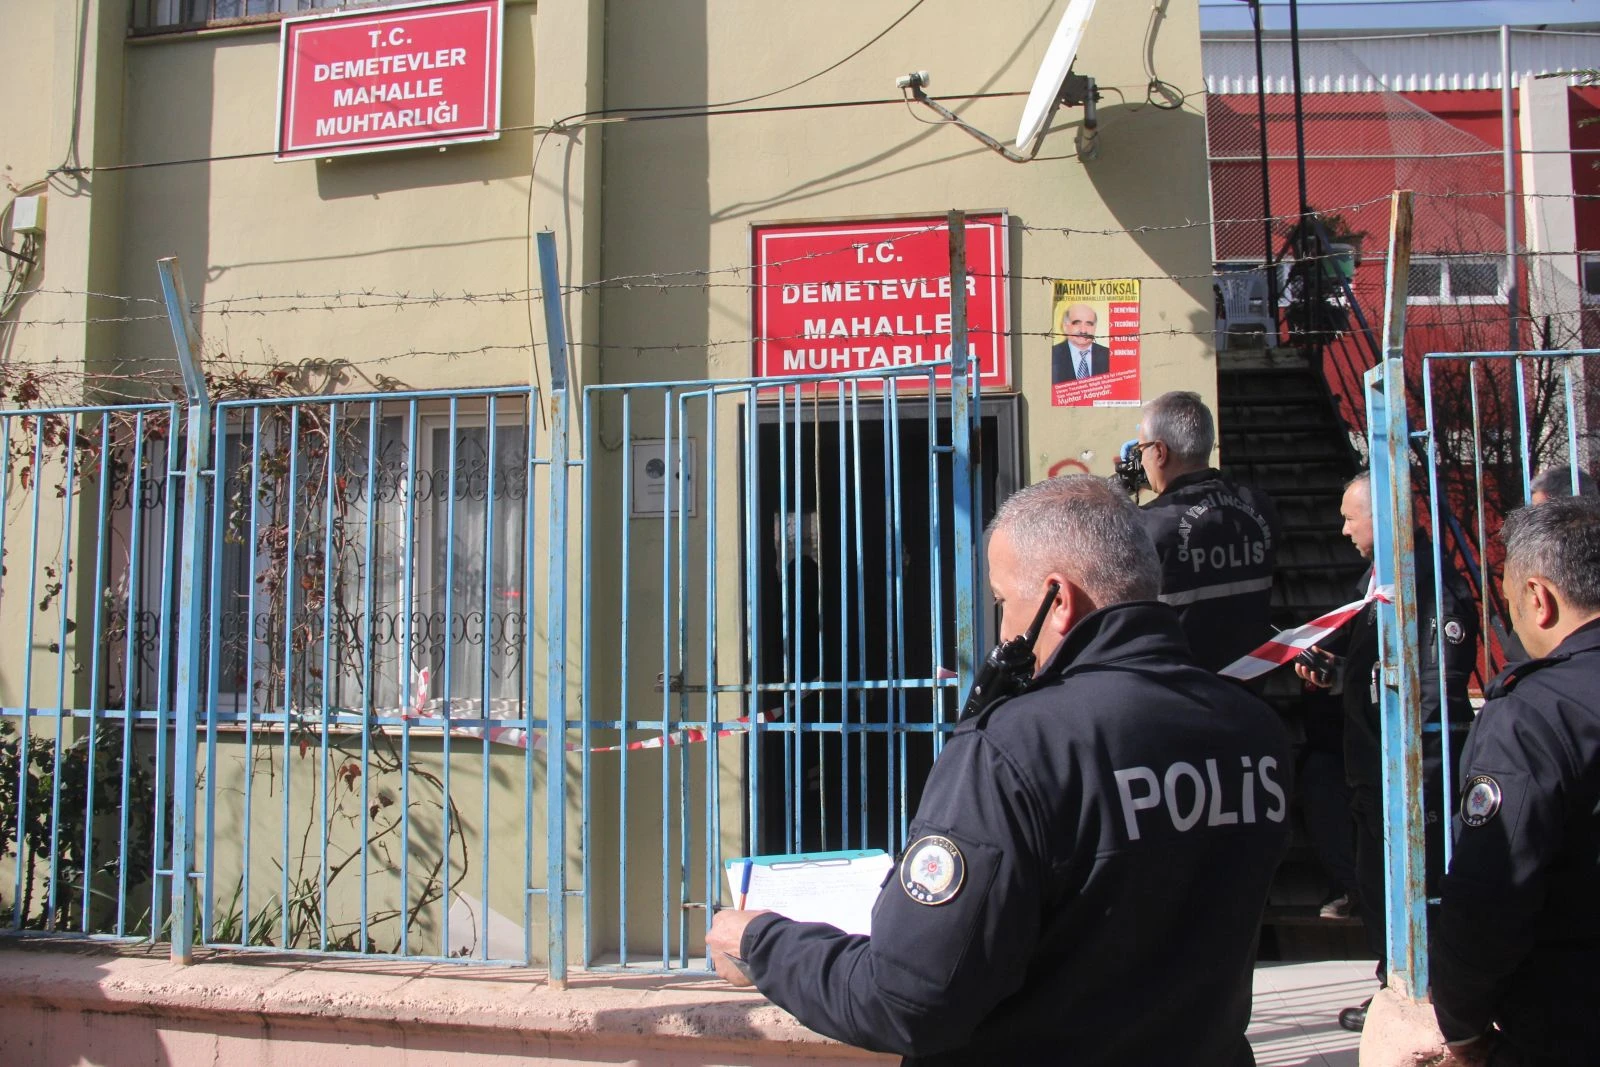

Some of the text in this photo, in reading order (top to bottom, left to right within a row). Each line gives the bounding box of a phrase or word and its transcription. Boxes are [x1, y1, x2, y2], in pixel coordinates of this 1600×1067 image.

[368, 28, 412, 47] T.C.
[314, 48, 467, 82] DEMETEVLER
[333, 78, 443, 107] MAHALLE
[316, 101, 458, 137] MUHTARLIĞI
[852, 242, 903, 264] T.C.
[1055, 281, 1138, 296] MAHMUT KÖKSAL
[804, 313, 952, 339] MAHALLE
[1191, 535, 1265, 573] POLİS
[1113, 755, 1286, 840] POLİS
